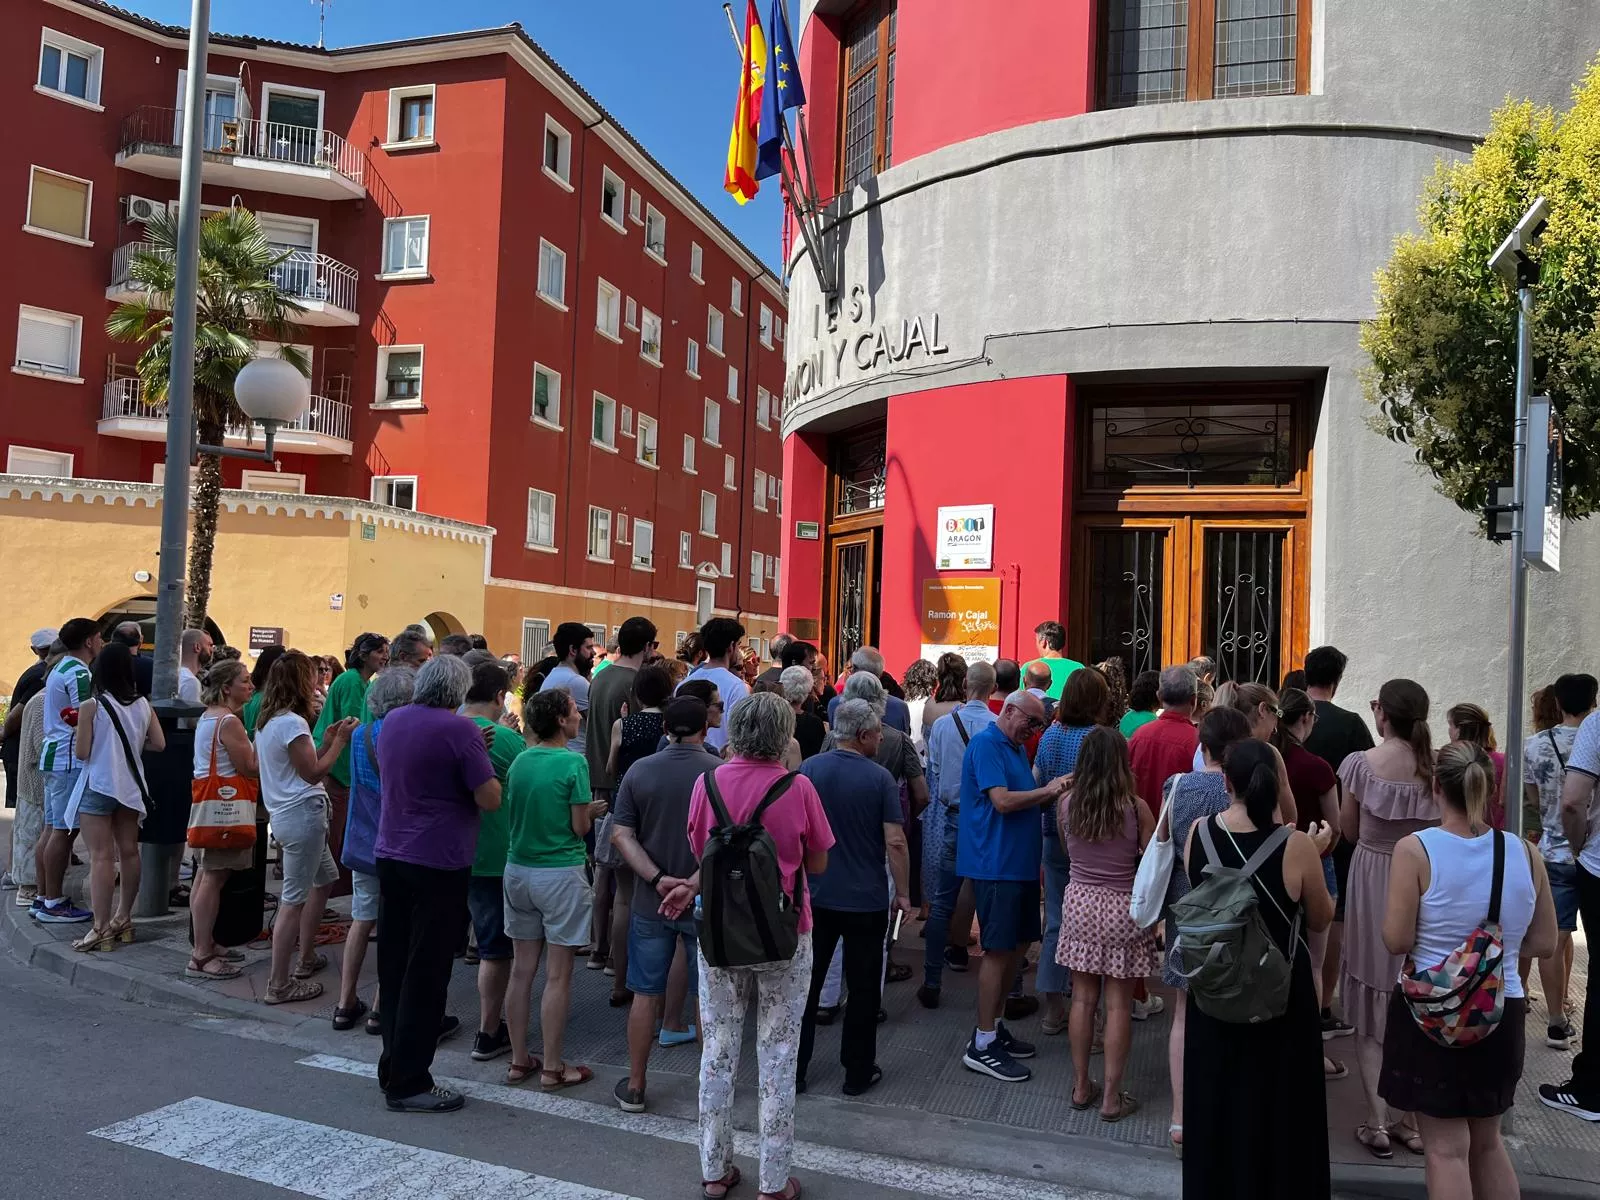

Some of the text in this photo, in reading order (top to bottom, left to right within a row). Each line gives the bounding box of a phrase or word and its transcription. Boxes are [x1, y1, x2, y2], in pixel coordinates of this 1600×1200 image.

[831, 339, 848, 380] Y
[854, 313, 949, 371] CAJAL
[946, 517, 985, 532] BRIT
[928, 609, 988, 621] Ramón y Cajal
